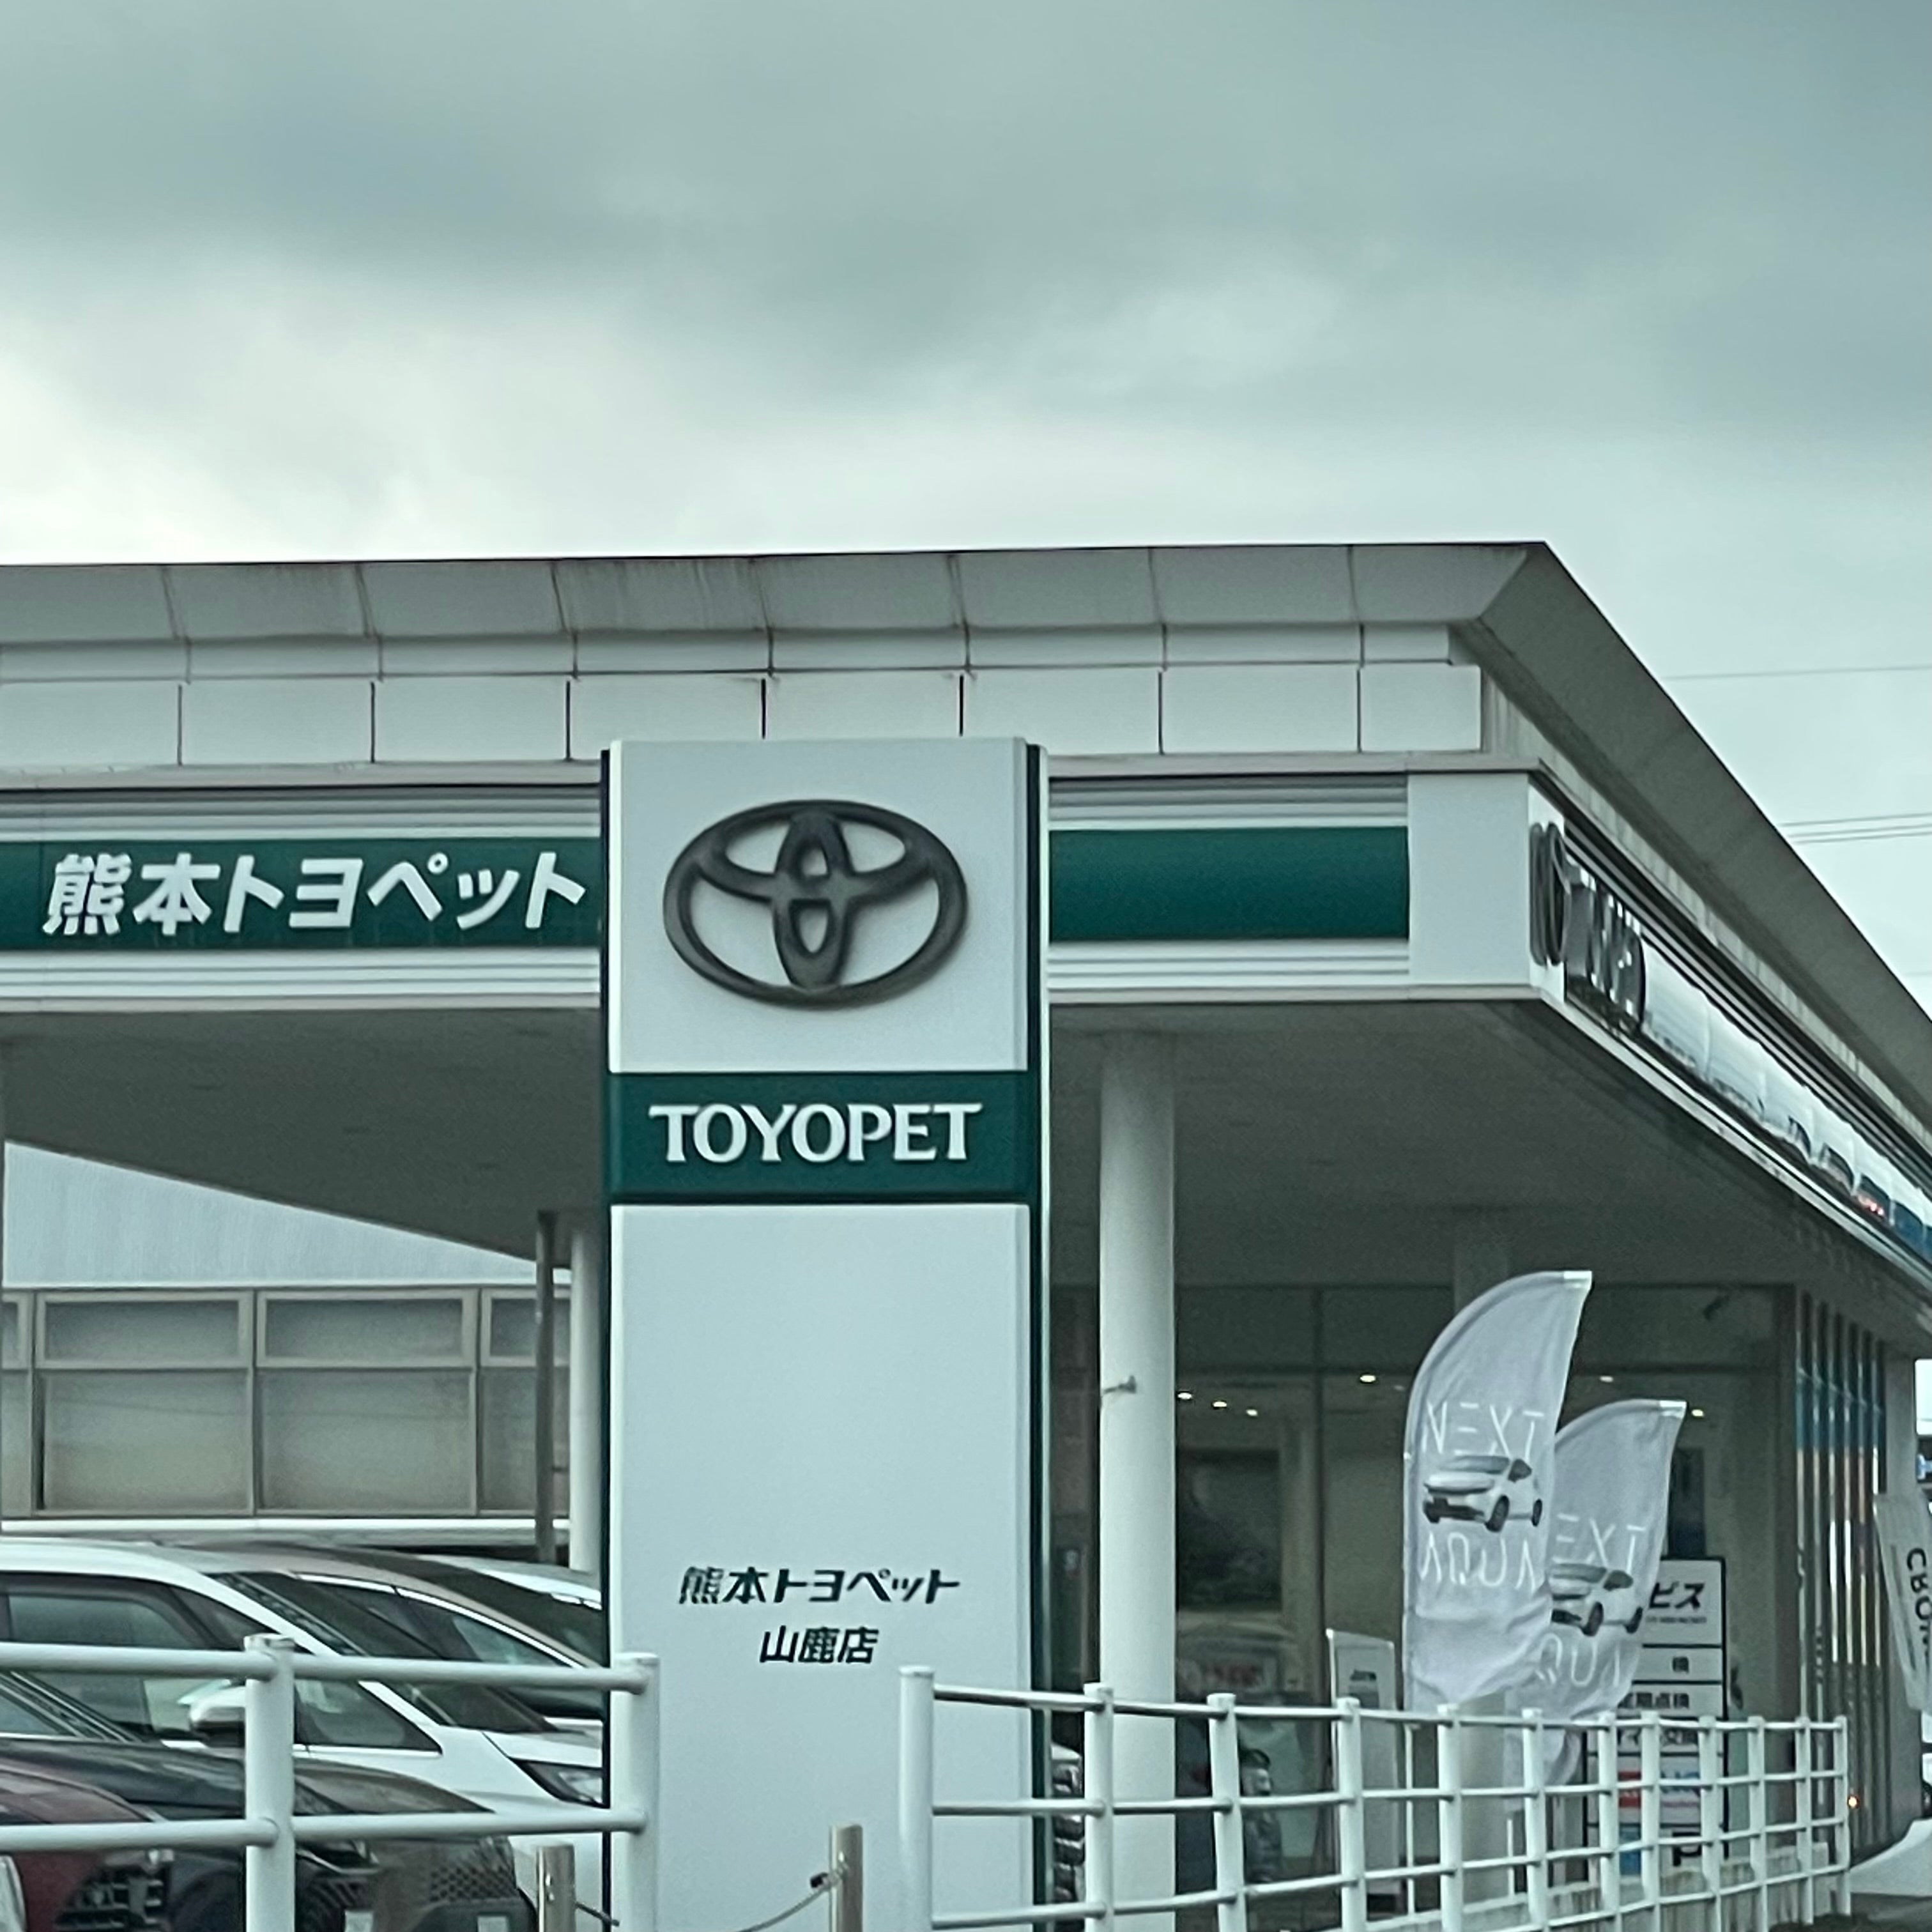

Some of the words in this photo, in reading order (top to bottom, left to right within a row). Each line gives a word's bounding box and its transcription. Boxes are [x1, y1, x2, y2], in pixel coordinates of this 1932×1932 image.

[42, 852, 586, 935] 熊本トヨペット
[648, 1103, 983, 1163] TOYOPET
[1552, 1512, 1646, 1574] EXT
[678, 1567, 960, 1604] 熊本トヨペット
[1648, 1581, 1705, 1609] ビス
[759, 1625, 879, 1664] 山鹿店
